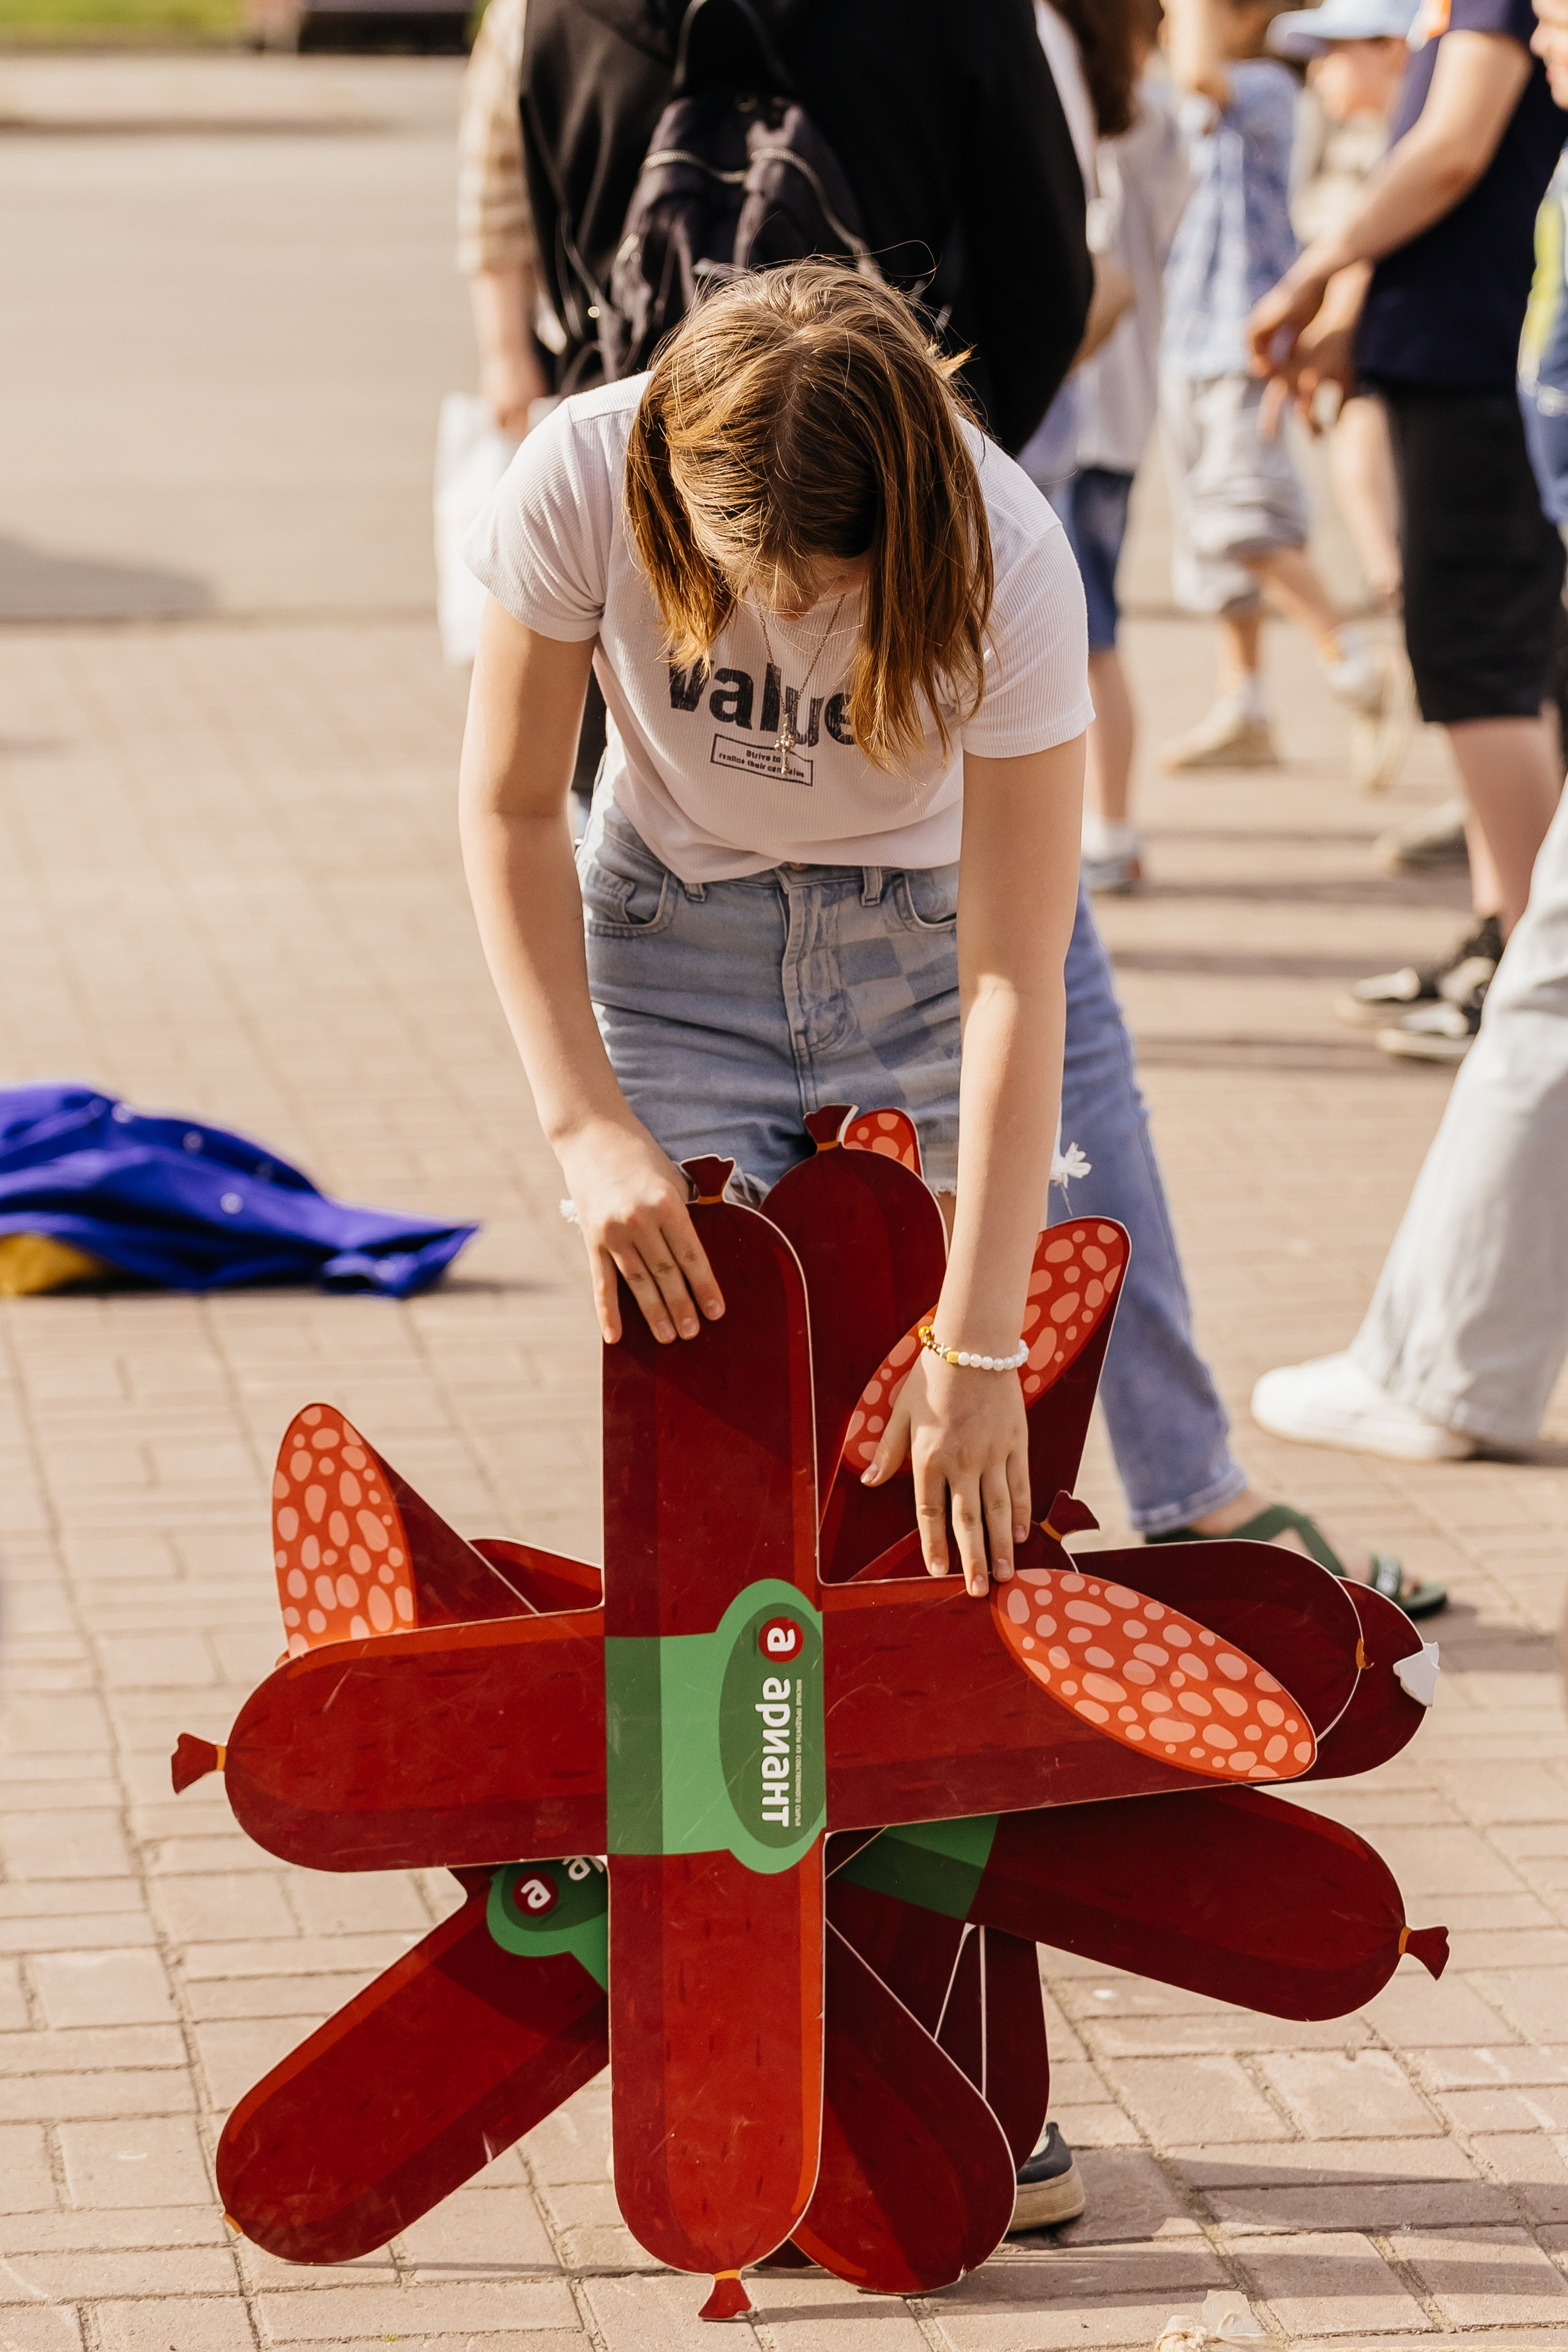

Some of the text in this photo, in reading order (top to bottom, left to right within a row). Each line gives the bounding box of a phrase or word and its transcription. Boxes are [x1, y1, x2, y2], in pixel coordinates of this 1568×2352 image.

[746, 750, 781, 763] Strive to
[788, 767, 805, 778] alue
[755, 1677, 791, 1827] ариант
[795, 1744, 802, 1754] ИЗ
